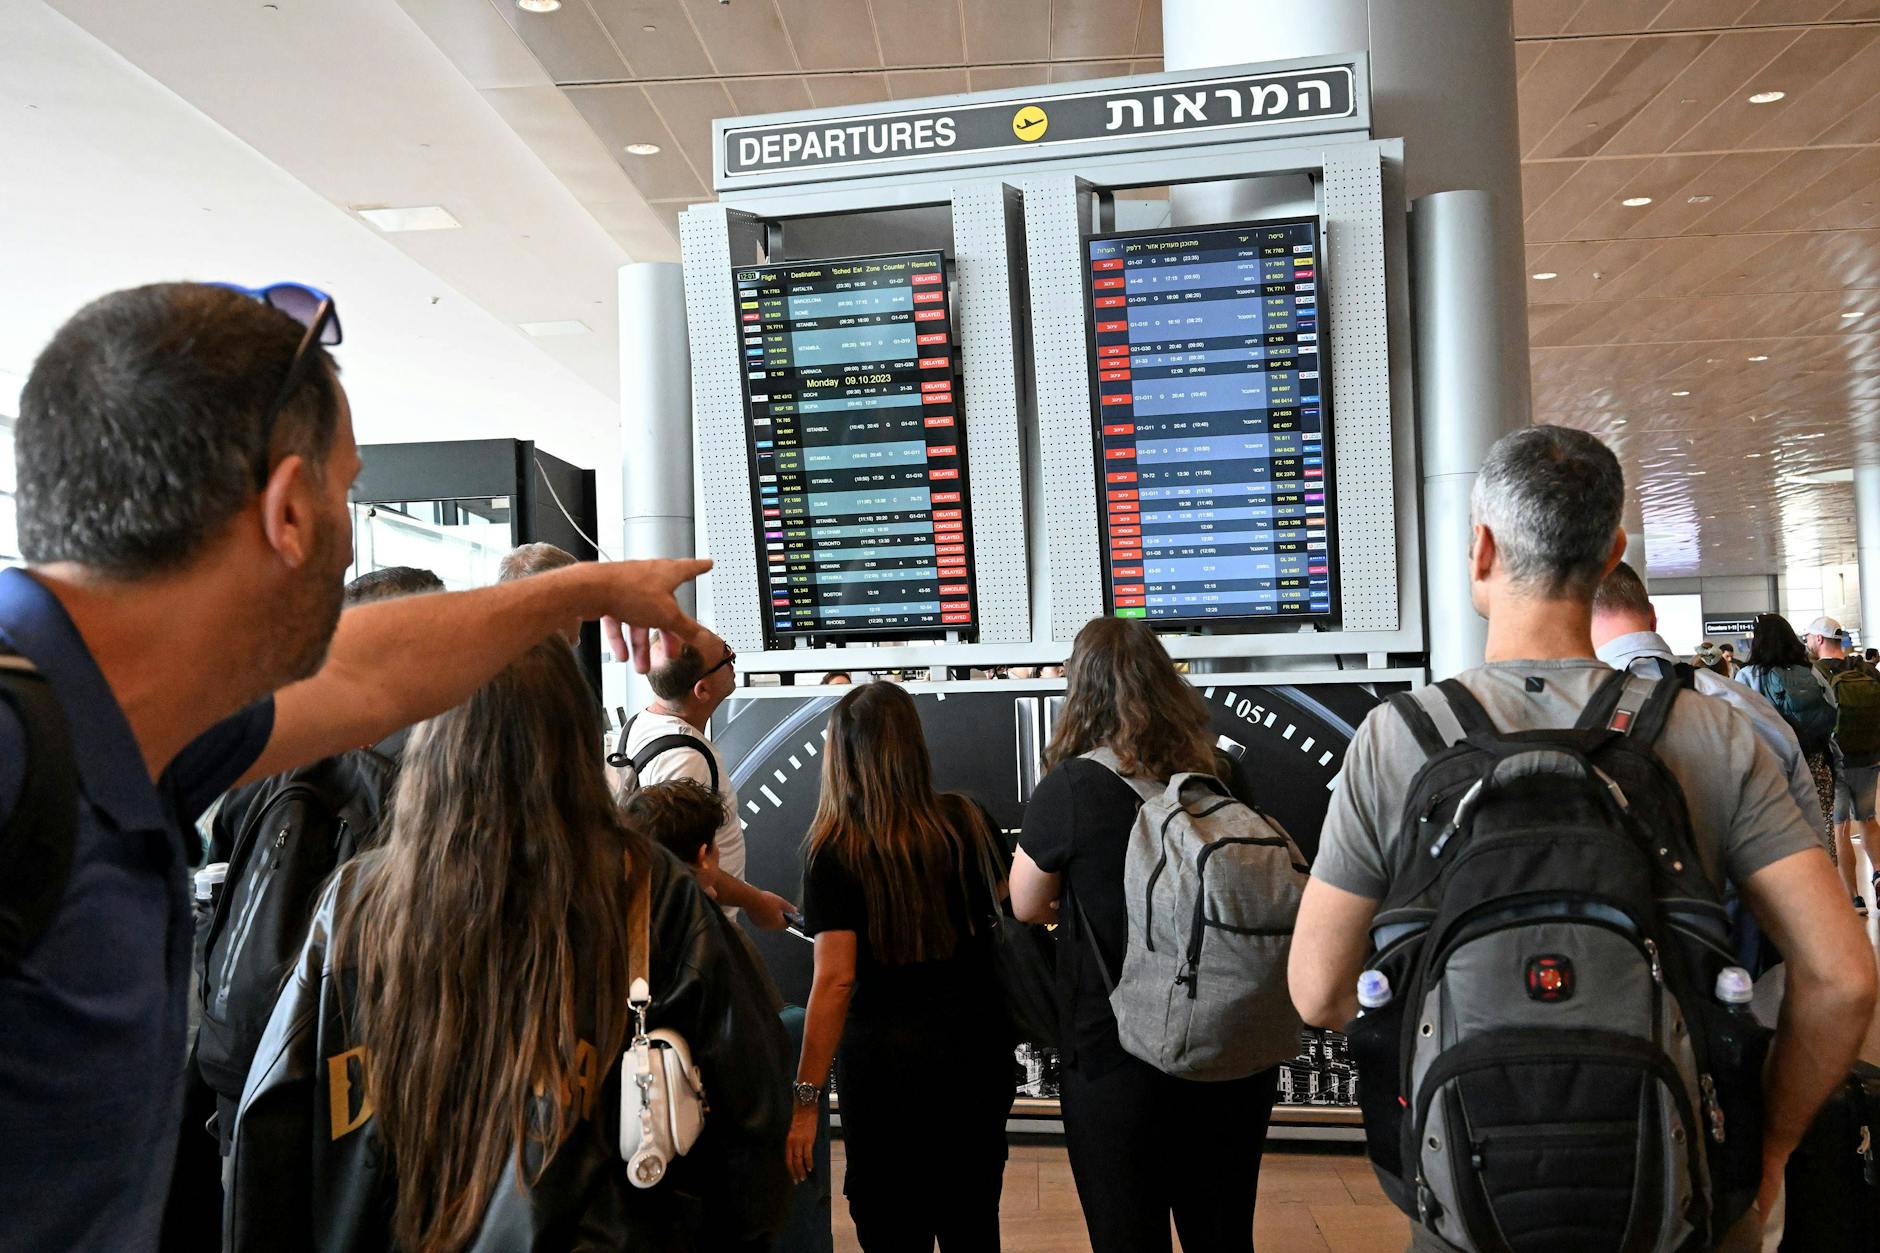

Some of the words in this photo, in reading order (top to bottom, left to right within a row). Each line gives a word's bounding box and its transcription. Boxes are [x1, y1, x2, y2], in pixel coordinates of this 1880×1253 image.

[1106, 79, 1331, 131] המראות
[739, 117, 957, 166] DEPARTURES
[790, 270, 821, 278] Destination
[844, 374, 891, 384] 09.10.2023
[1236, 699, 1265, 724] 05
